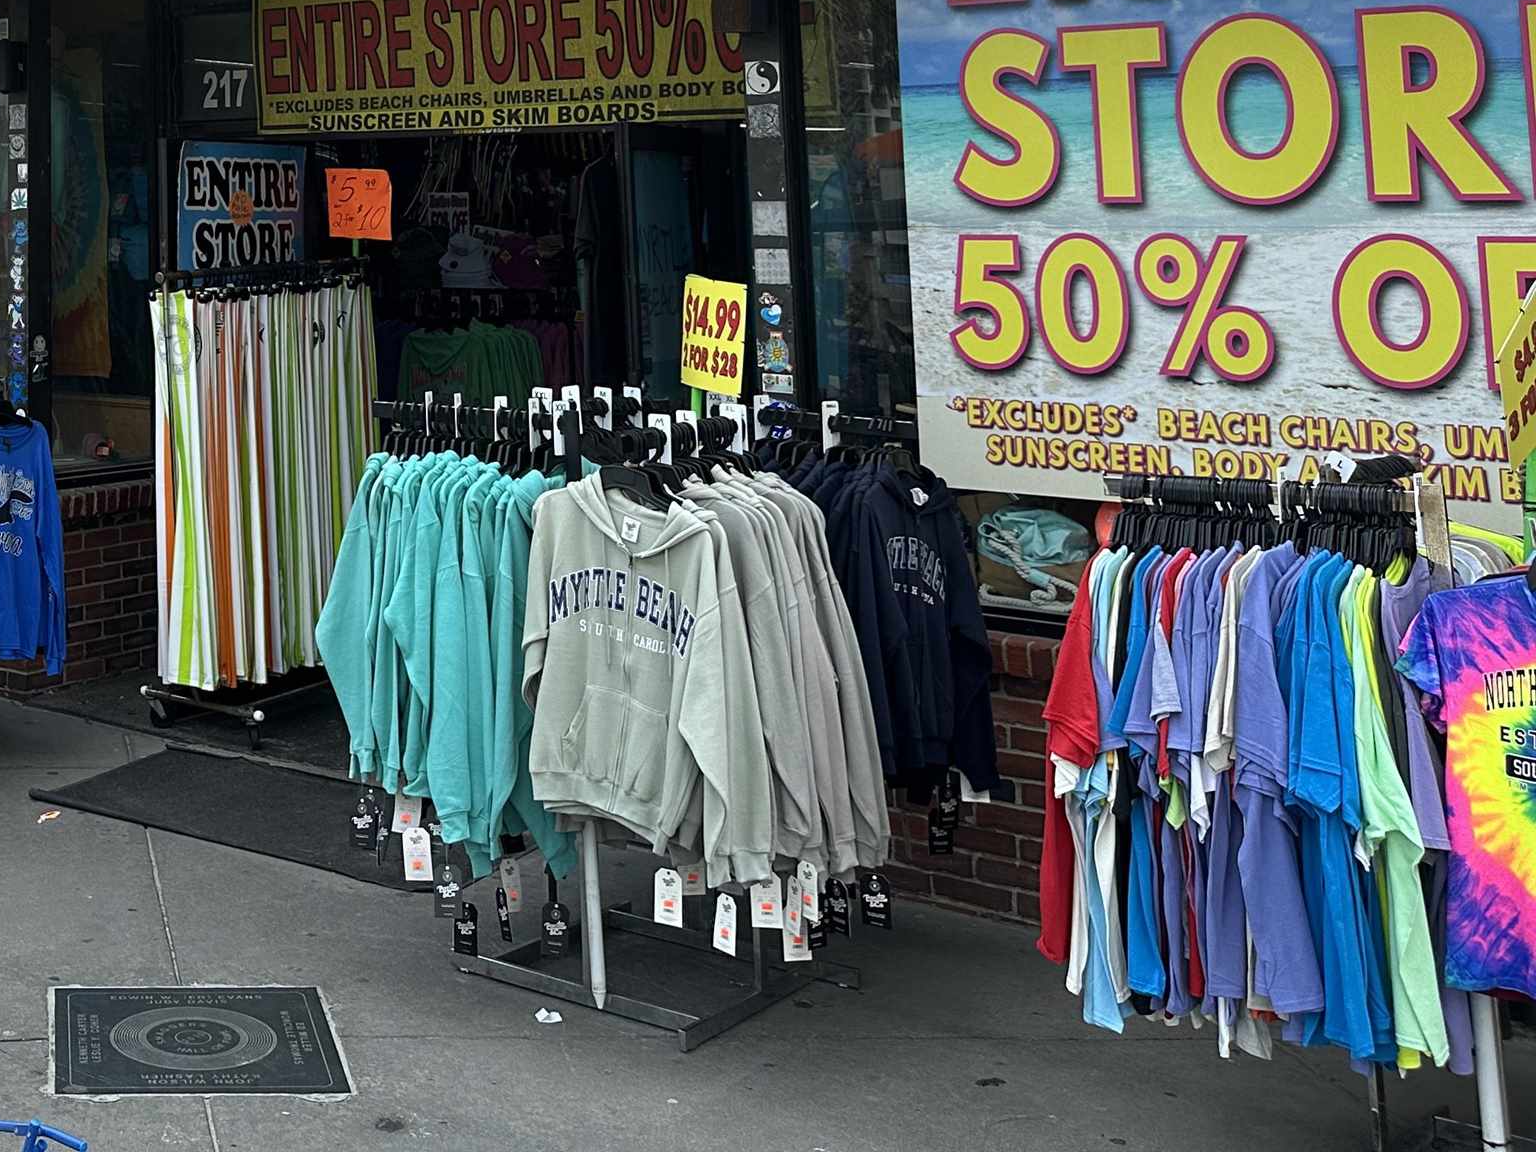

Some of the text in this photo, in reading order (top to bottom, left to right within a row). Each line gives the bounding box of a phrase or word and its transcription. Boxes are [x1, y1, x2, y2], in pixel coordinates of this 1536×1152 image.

[202, 69, 248, 109] 217
[359, 94, 417, 110] BEACH
[423, 91, 488, 108] CHAIRS,
[494, 85, 605, 105] UMBRELLAS
[611, 83, 652, 100] AND
[659, 80, 715, 98] BODY
[309, 102, 656, 131] SUNSCREEN AND SKIM BOARDS
[184, 157, 300, 210] ENTIRE
[193, 220, 296, 269] STORE
[684, 288, 741, 342] $14.99
[950, 233, 1274, 381] 50%
[1333, 233, 1536, 389] OF
[683, 343, 738, 379] 2 FOR $28
[1157, 408, 1270, 447] BEACH
[1280, 416, 1431, 459] CHAIRS,
[635, 575, 697, 659] BEAH
